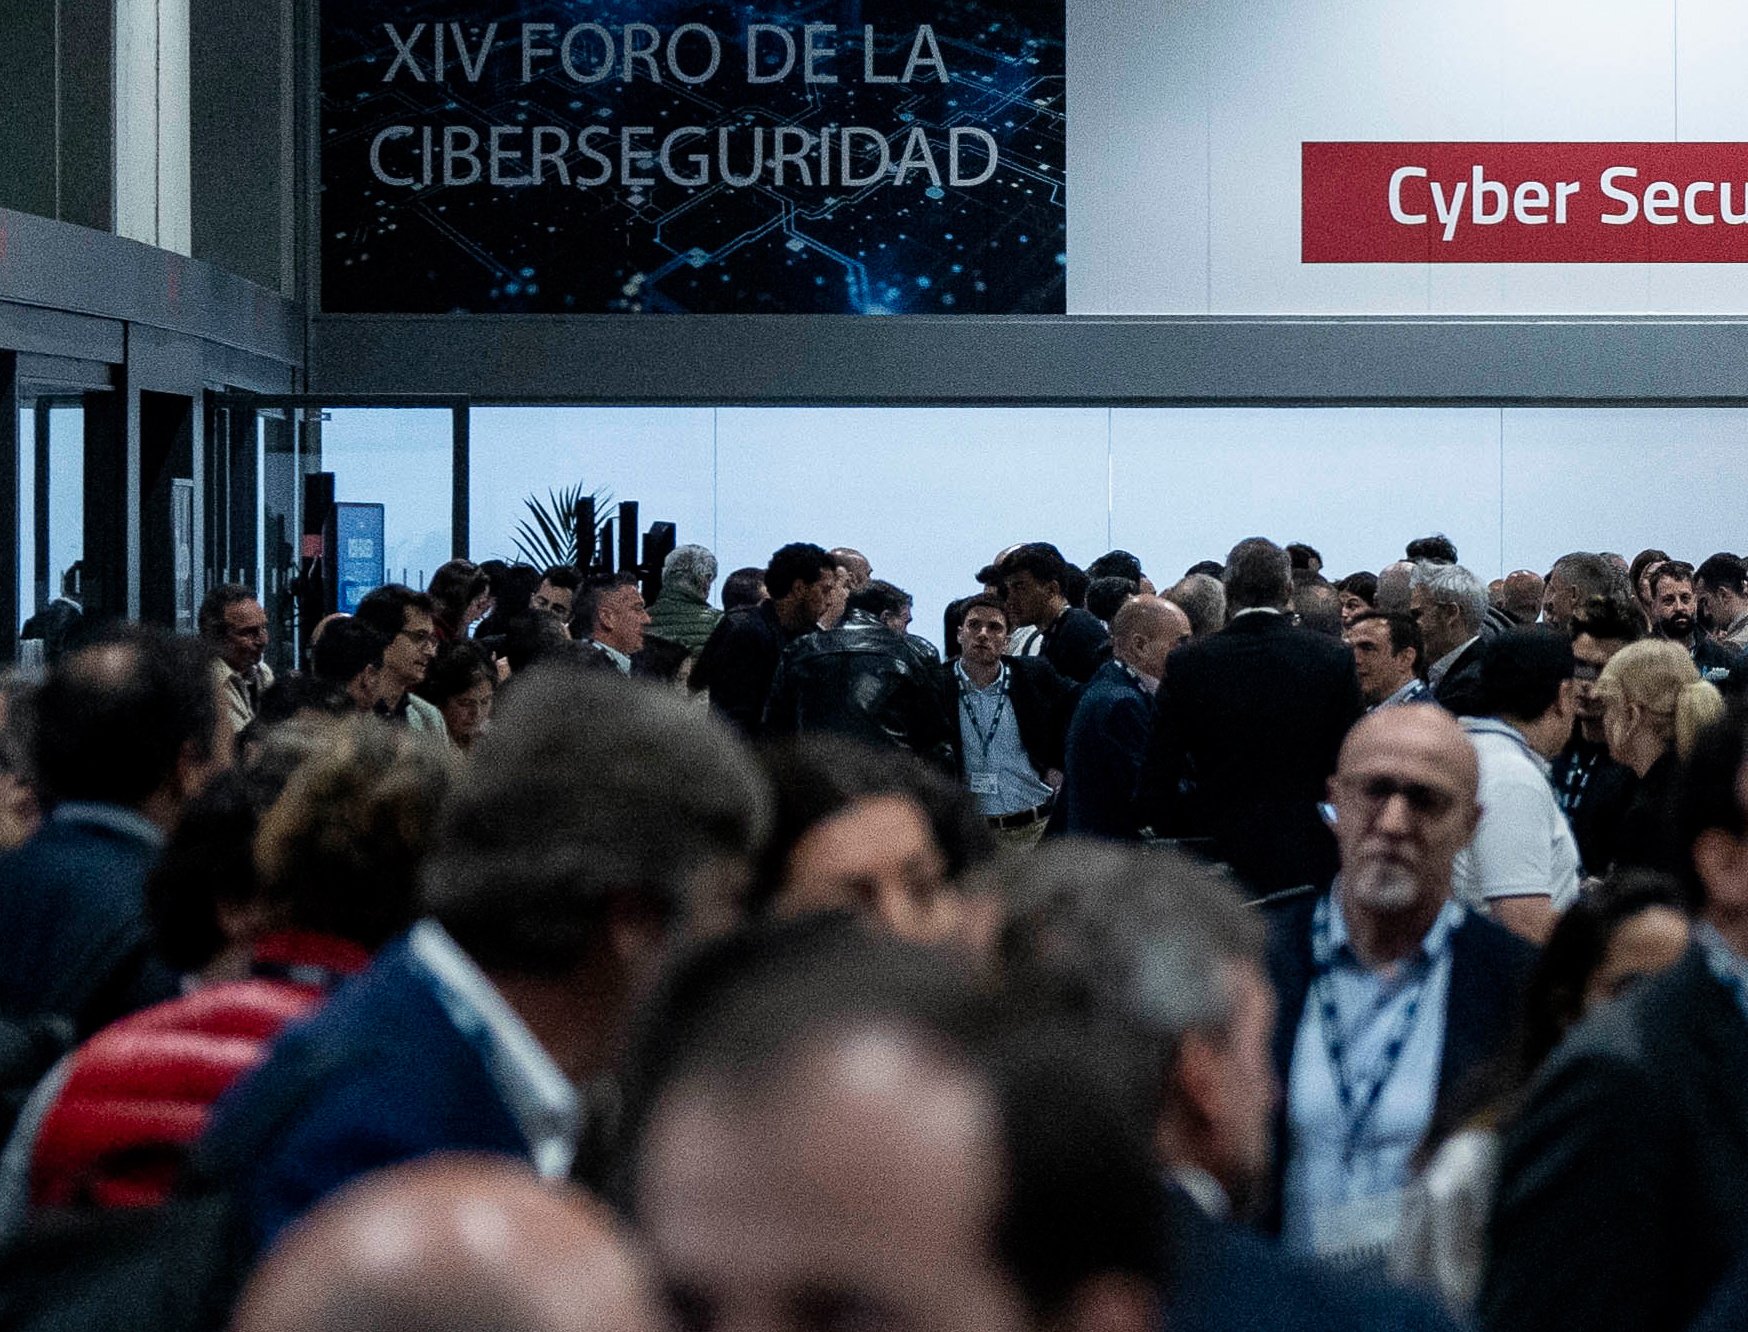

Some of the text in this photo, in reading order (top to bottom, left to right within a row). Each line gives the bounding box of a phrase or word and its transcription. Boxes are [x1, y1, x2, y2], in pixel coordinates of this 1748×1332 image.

[382, 23, 950, 84] XIV FORO DE LA
[369, 125, 1001, 188] CIBERSEGURIDAD
[1387, 163, 1581, 242] Cyber
